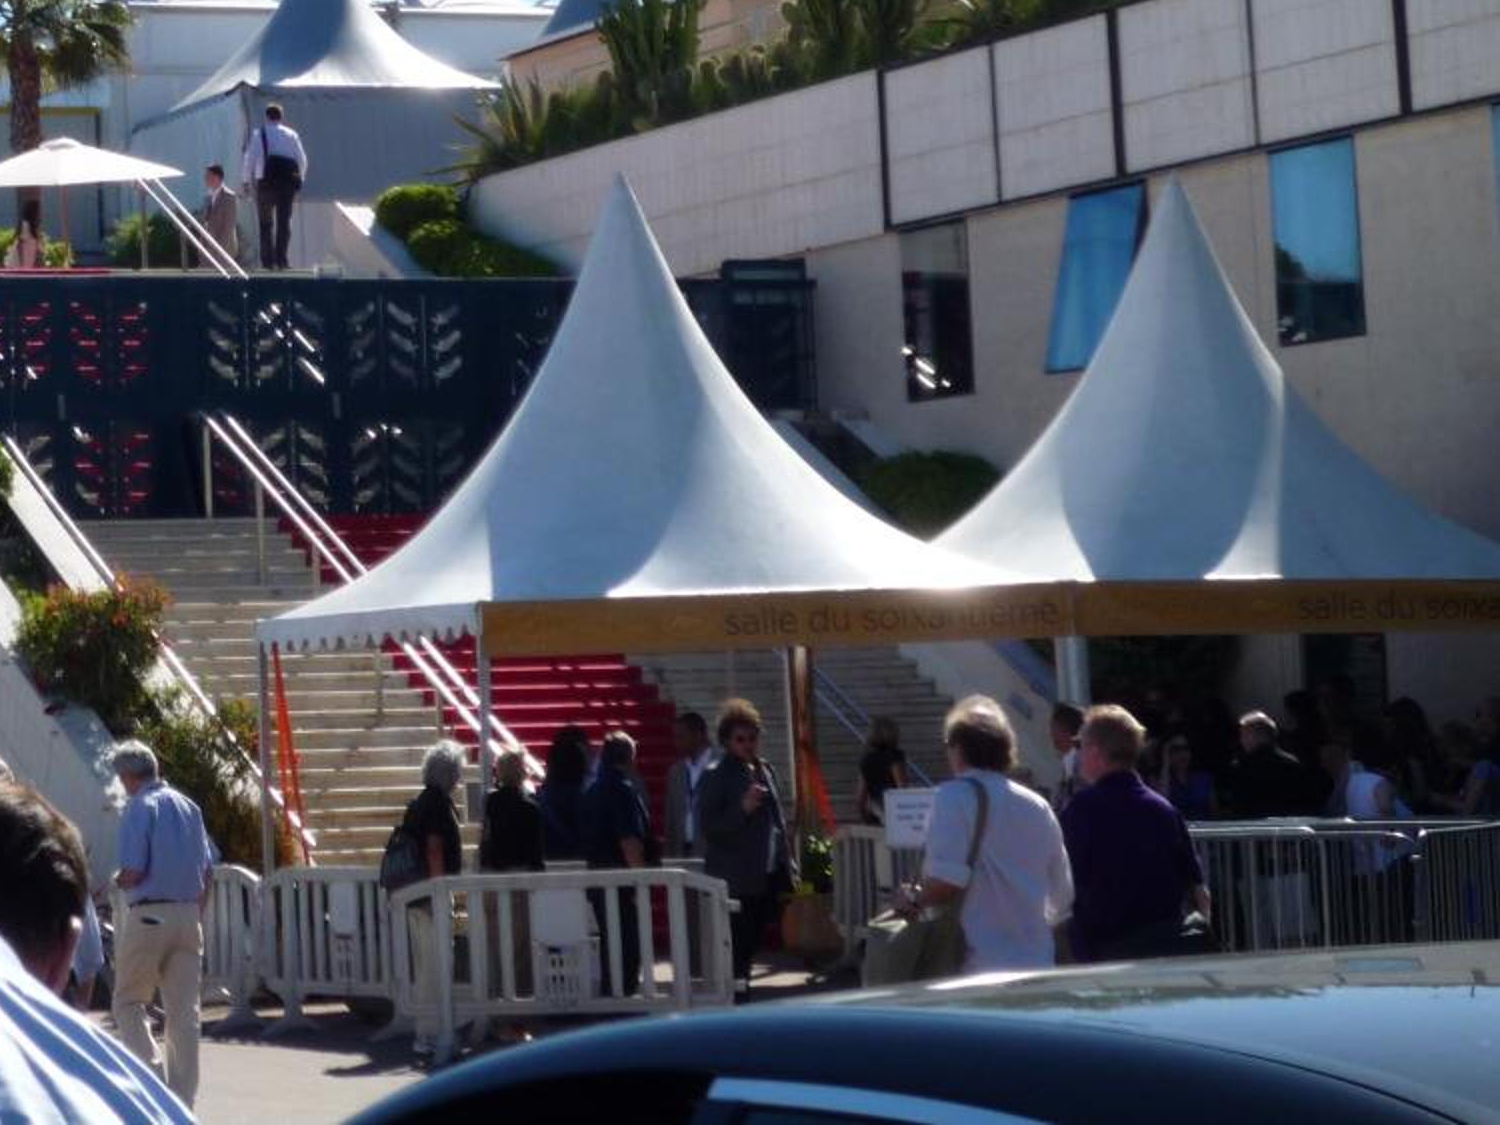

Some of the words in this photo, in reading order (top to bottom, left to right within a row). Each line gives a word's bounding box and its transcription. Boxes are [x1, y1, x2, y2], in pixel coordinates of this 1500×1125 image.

[725, 603, 798, 636] salle
[811, 602, 851, 633] du
[1299, 589, 1365, 620] salle
[1378, 587, 1414, 620] du
